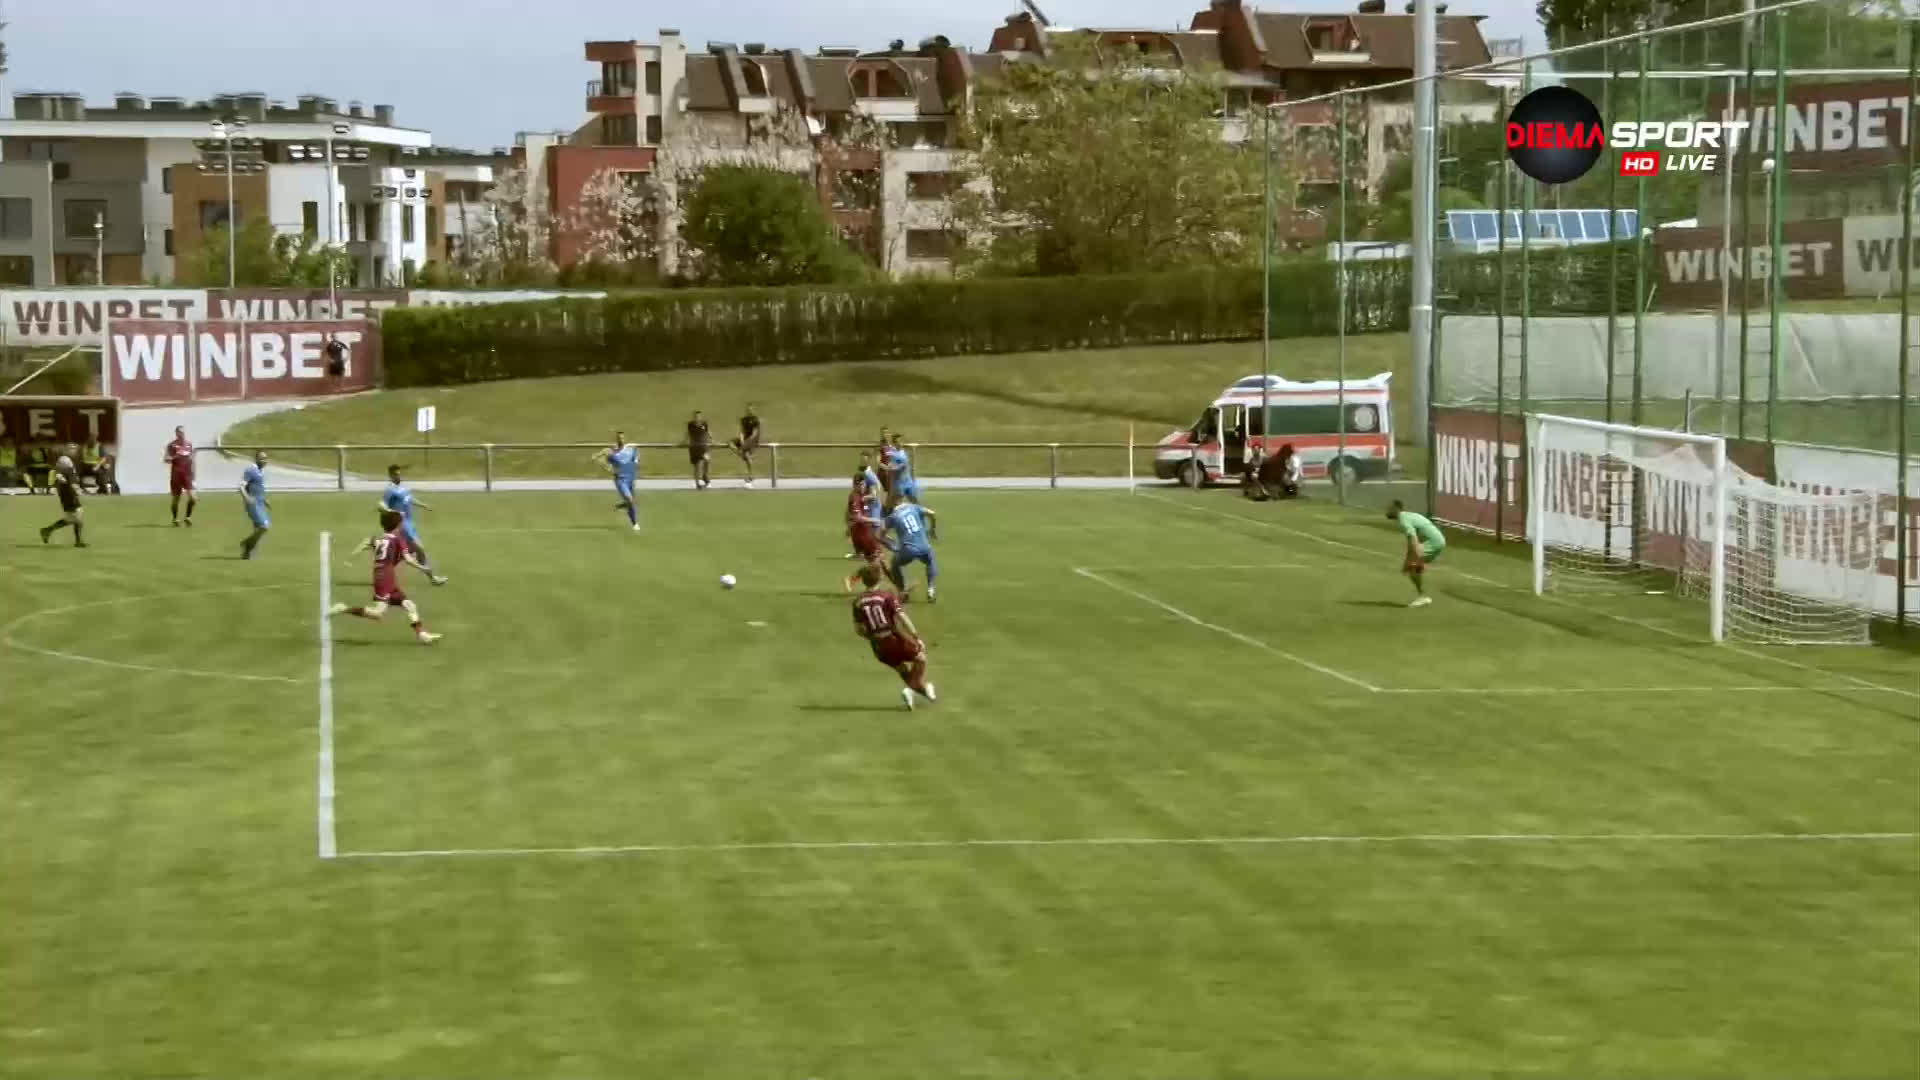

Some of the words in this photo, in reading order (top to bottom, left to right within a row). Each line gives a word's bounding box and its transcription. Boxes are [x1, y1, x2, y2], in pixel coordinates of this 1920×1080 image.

[1665, 241, 1833, 283] WINBET
[113, 331, 363, 380] WINBET
[0, 408, 107, 440] ET
[1436, 432, 1521, 506] WINBET
[903, 514, 921, 534] 19
[863, 605, 888, 631] 10
